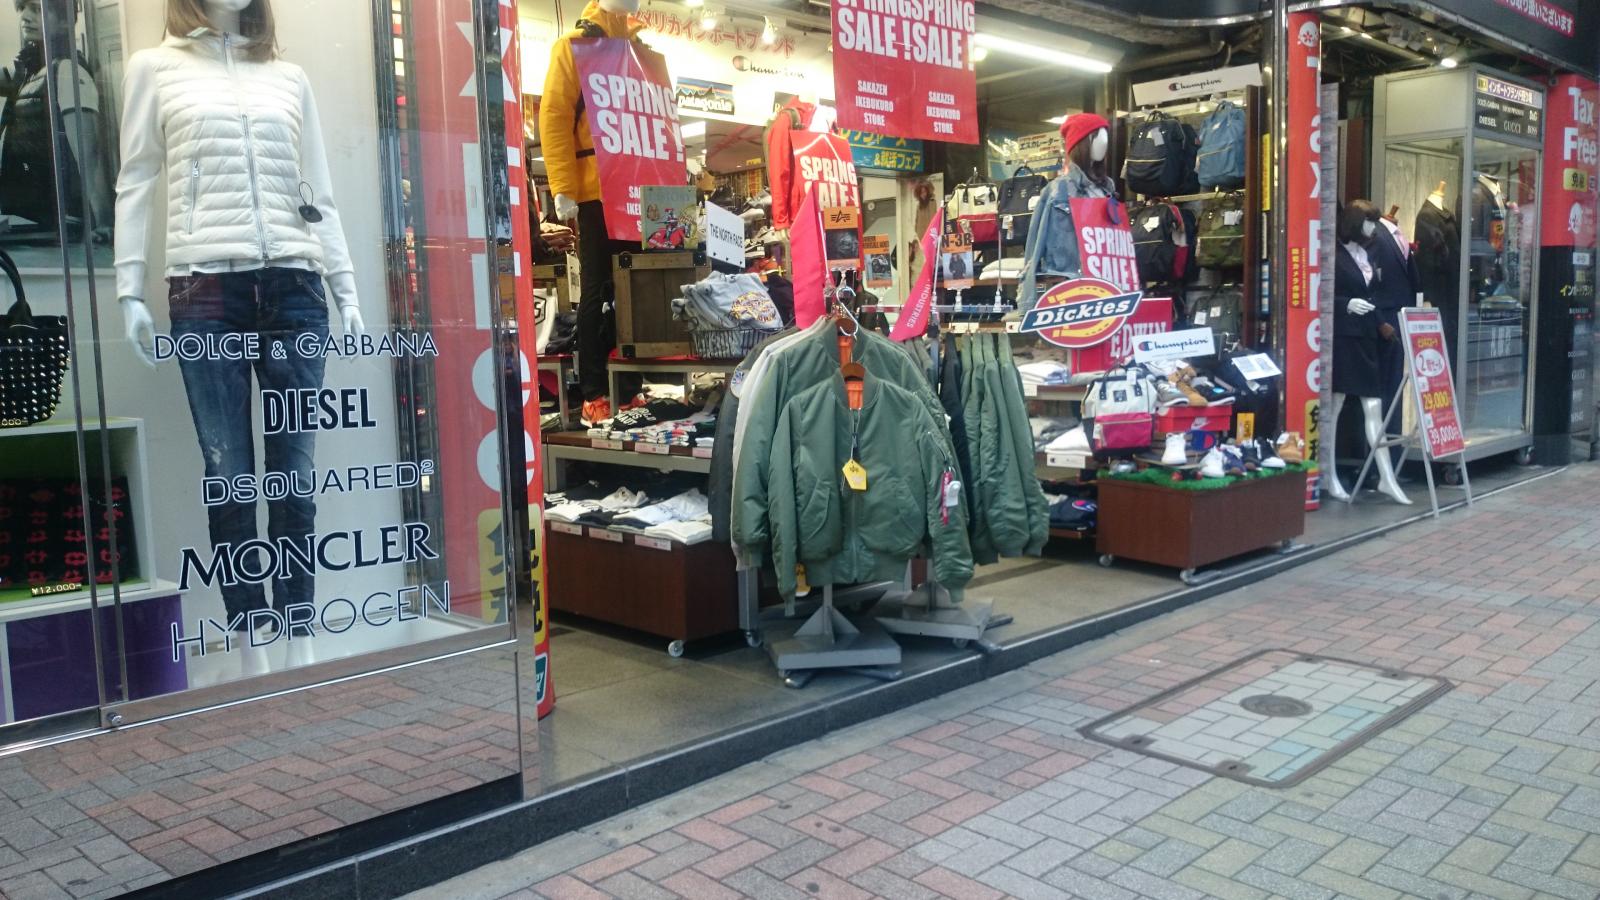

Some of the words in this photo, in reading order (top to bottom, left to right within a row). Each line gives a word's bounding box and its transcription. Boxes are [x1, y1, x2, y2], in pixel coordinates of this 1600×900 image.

[588, 73, 679, 120] SPRING
[857, 79, 888, 96] SAKAZEN
[928, 90, 955, 106] SAKAZEN
[1168, 78, 1222, 92] Champion
[677, 94, 733, 113] patagonia
[855, 95, 894, 113] IKEBUKURO
[926, 105, 961, 121] IKEBUKURO
[1568, 86, 1594, 127] Tax
[863, 111, 886, 127] STORE
[933, 121, 954, 134] STORE
[1563, 127, 1597, 166] Free
[799, 155, 858, 186] SPRING
[710, 223, 719, 239] THE
[719, 227, 733, 245] NORTH
[733, 233, 743, 249] FACE
[1081, 226, 1136, 259] SPRING
[1032, 299, 1131, 327] Dickies
[153, 332, 260, 361] DOLCE
[271, 340, 288, 360] &
[296, 331, 439, 359] GABBANA
[1138, 337, 1209, 352] Champion
[261, 388, 377, 435] DIESEL
[178, 522, 440, 592] MONCLER
[171, 581, 450, 662] HYDROGEN
